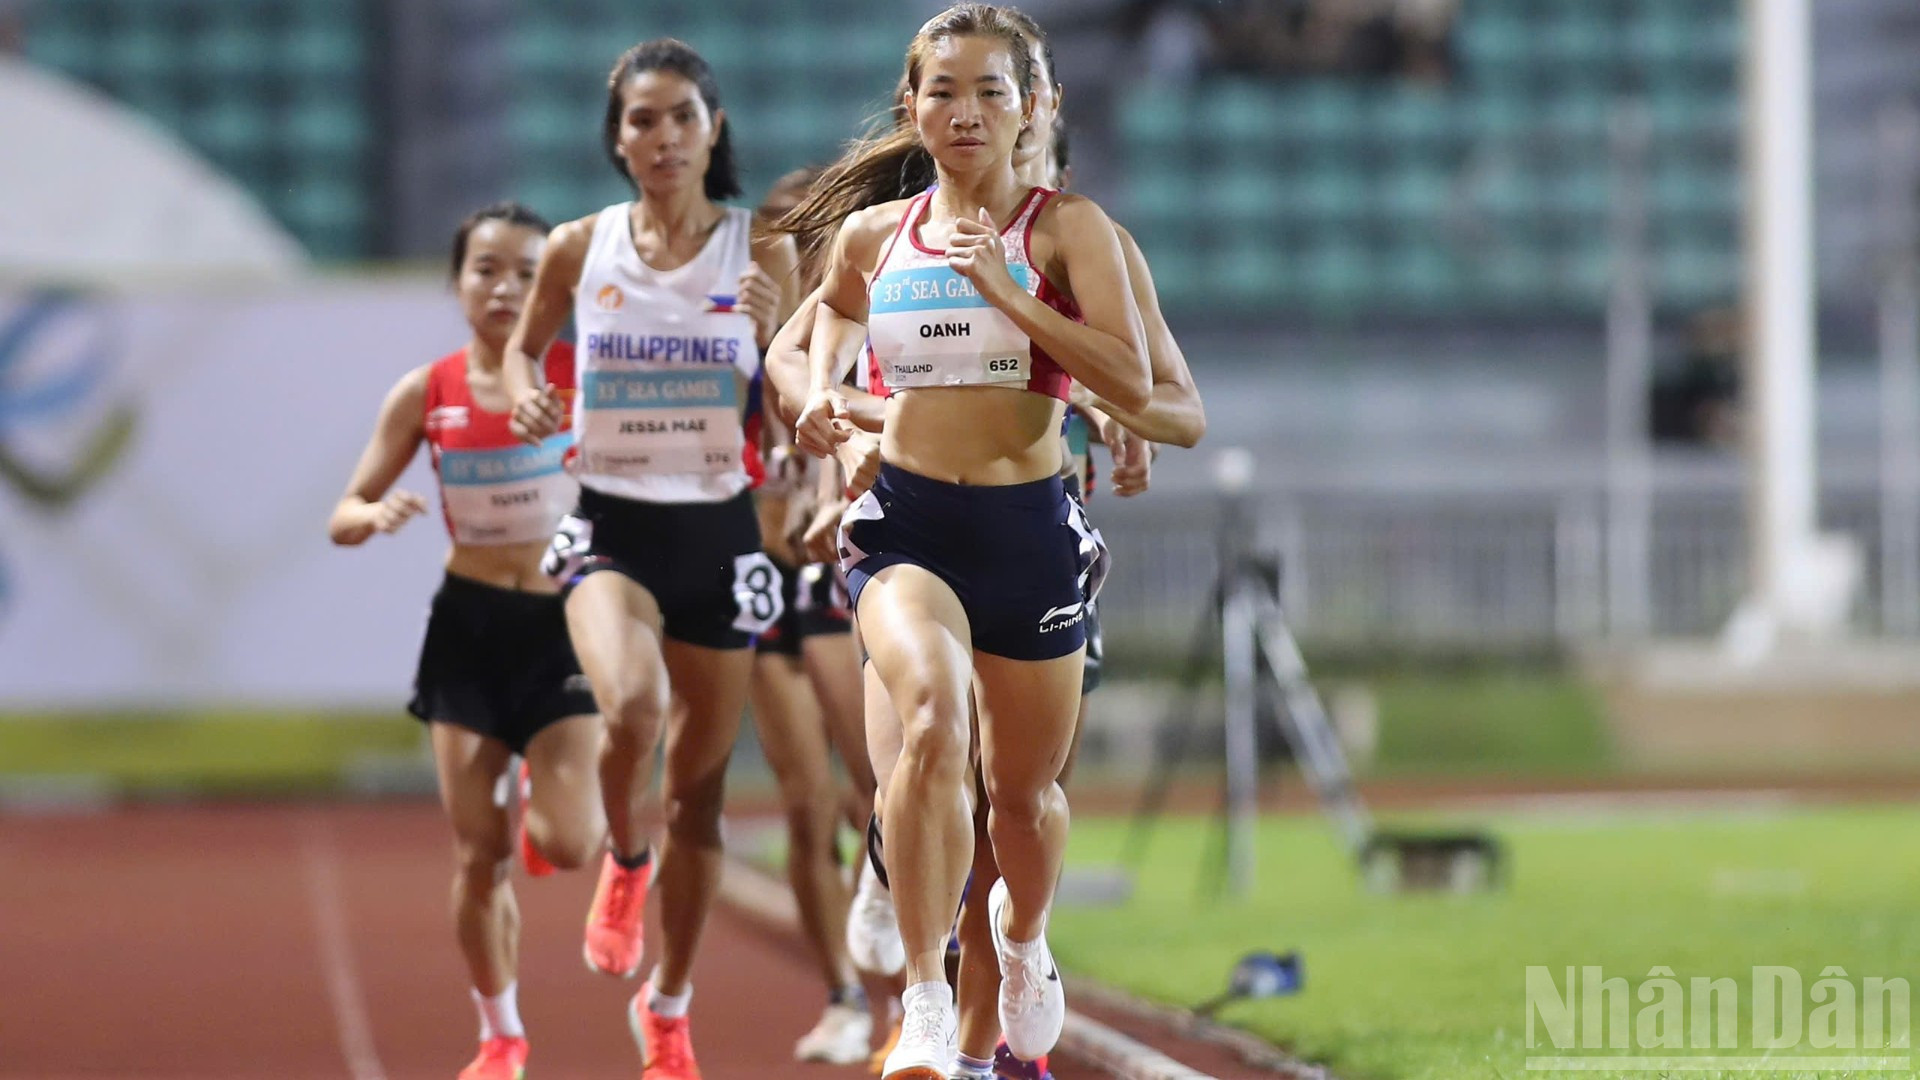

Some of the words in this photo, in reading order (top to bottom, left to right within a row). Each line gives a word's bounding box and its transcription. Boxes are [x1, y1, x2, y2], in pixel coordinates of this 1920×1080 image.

[911, 279, 941, 300] SEA
[919, 322, 971, 338] OANH
[588, 332, 740, 363] PHILIPPINES
[894, 364, 933, 374] THAILAND
[989, 359, 1018, 372] 652
[627, 380, 658, 399] SEA
[661, 378, 721, 399] GAMES
[619, 419, 668, 434] JESSA
[672, 418, 708, 433] MAE
[745, 565, 775, 621] 8
